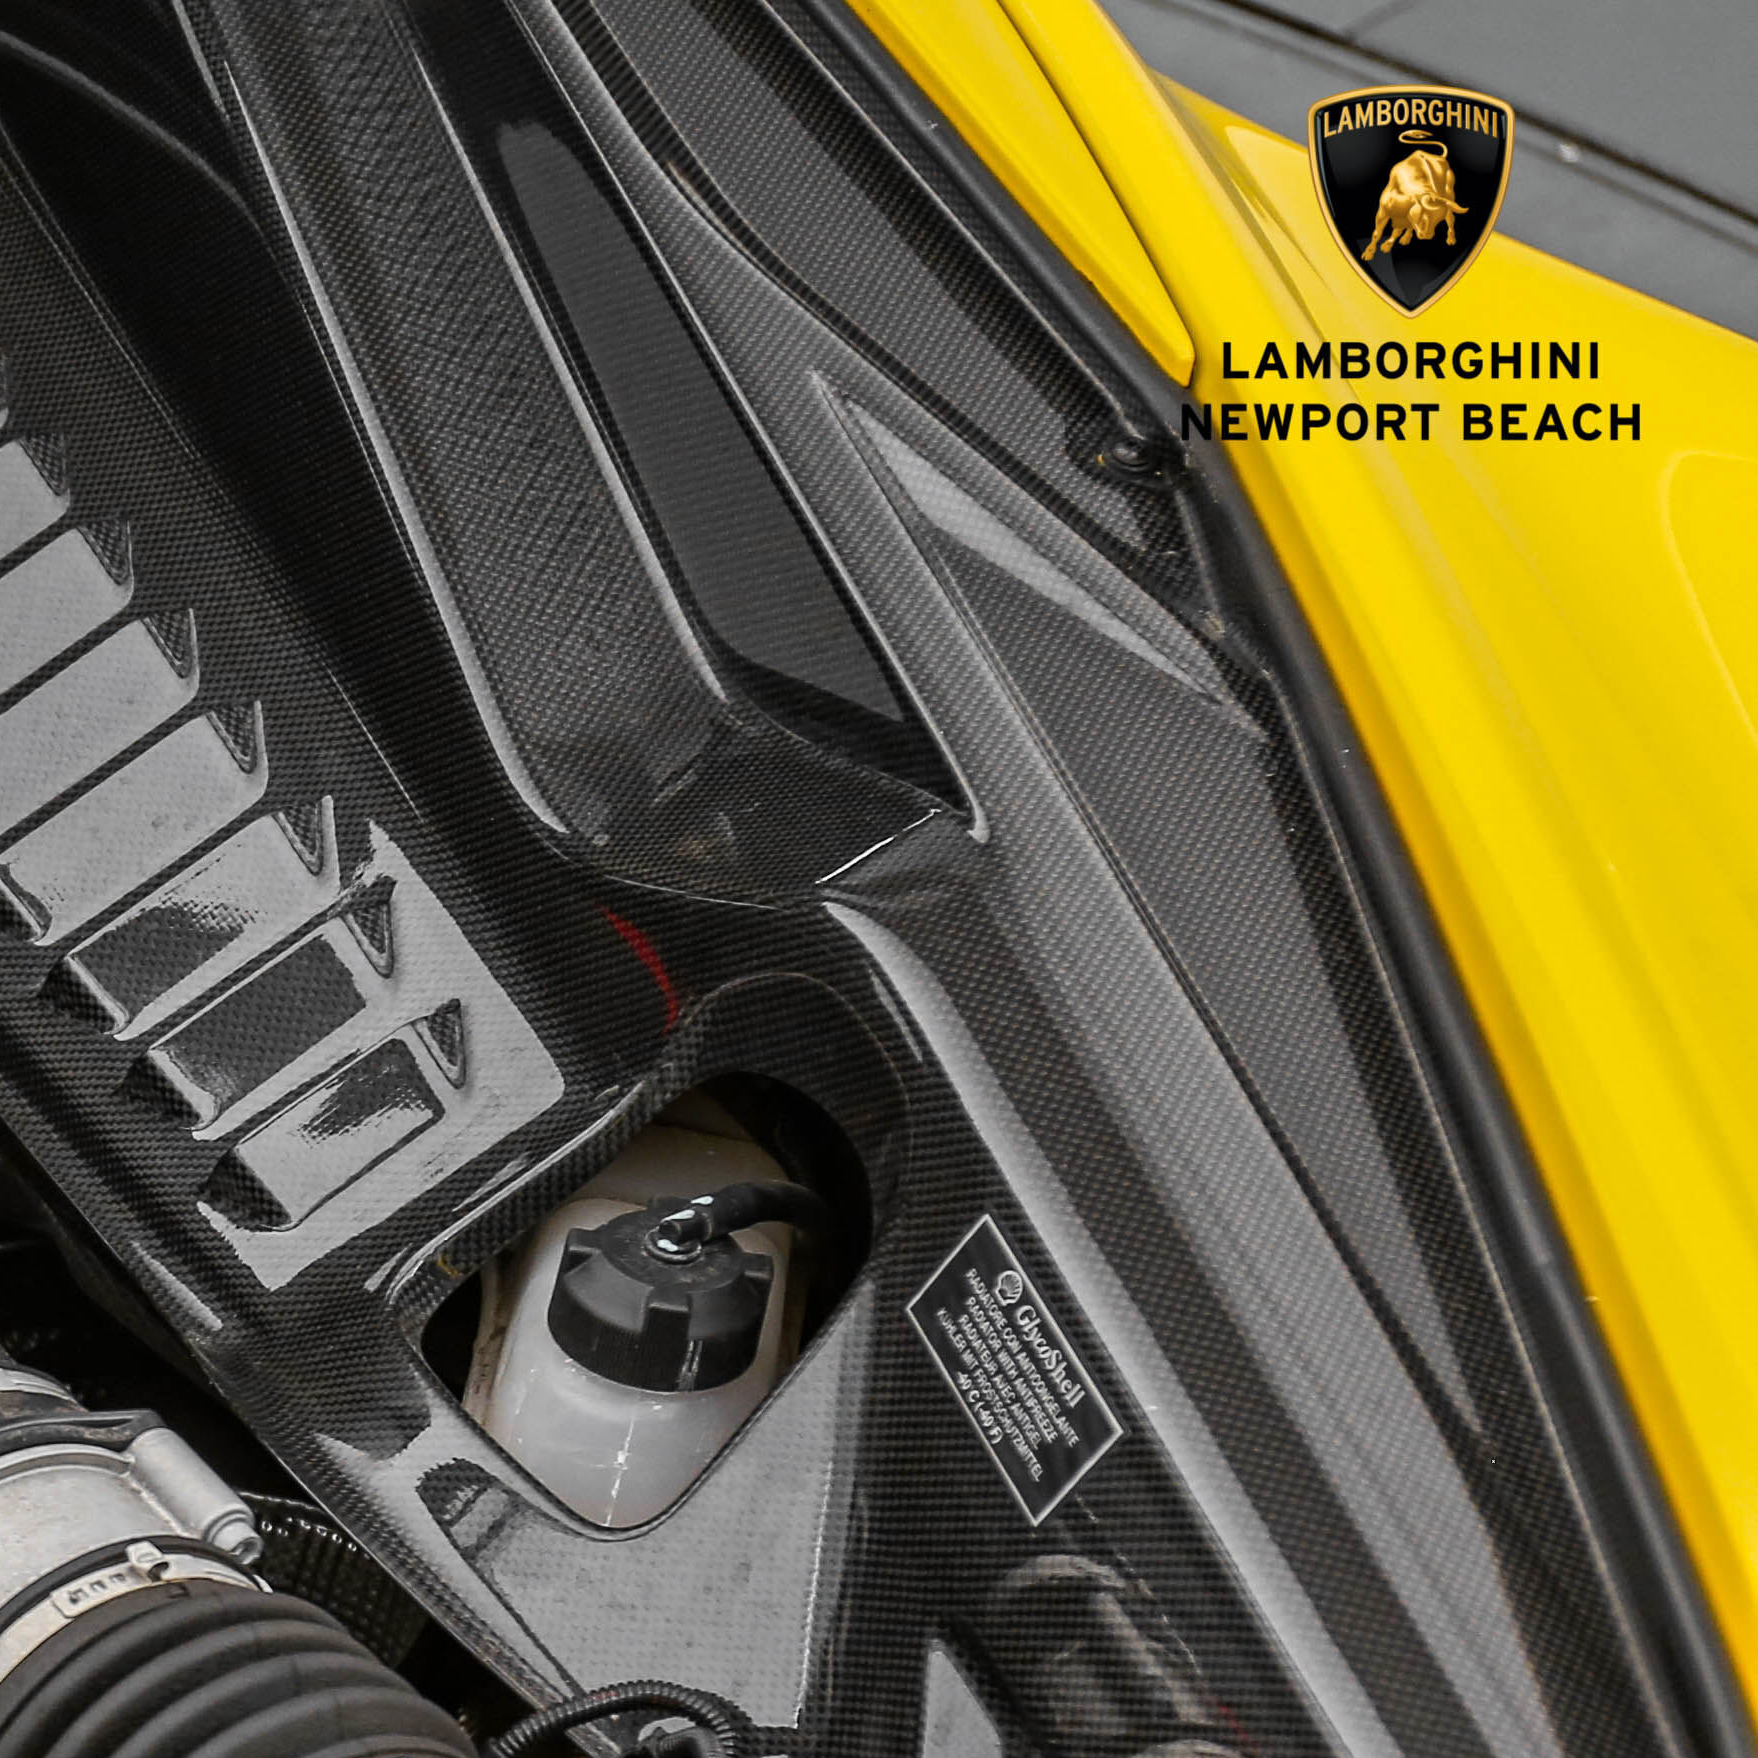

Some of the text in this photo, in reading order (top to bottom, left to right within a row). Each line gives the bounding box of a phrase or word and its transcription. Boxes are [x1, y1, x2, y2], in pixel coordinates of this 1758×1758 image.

[958, 1313, 1043, 1449] RADIATEUR AVEC ANTIGEL
[961, 1348, 978, 1371] MIT
[965, 1296, 1057, 1443] RADIATOR WITH ANTIFREEZE
[966, 1268, 1078, 1447] RADIATORE CON ANTICONGELANTE
[1013, 1303, 1087, 1410] GlycoShell
